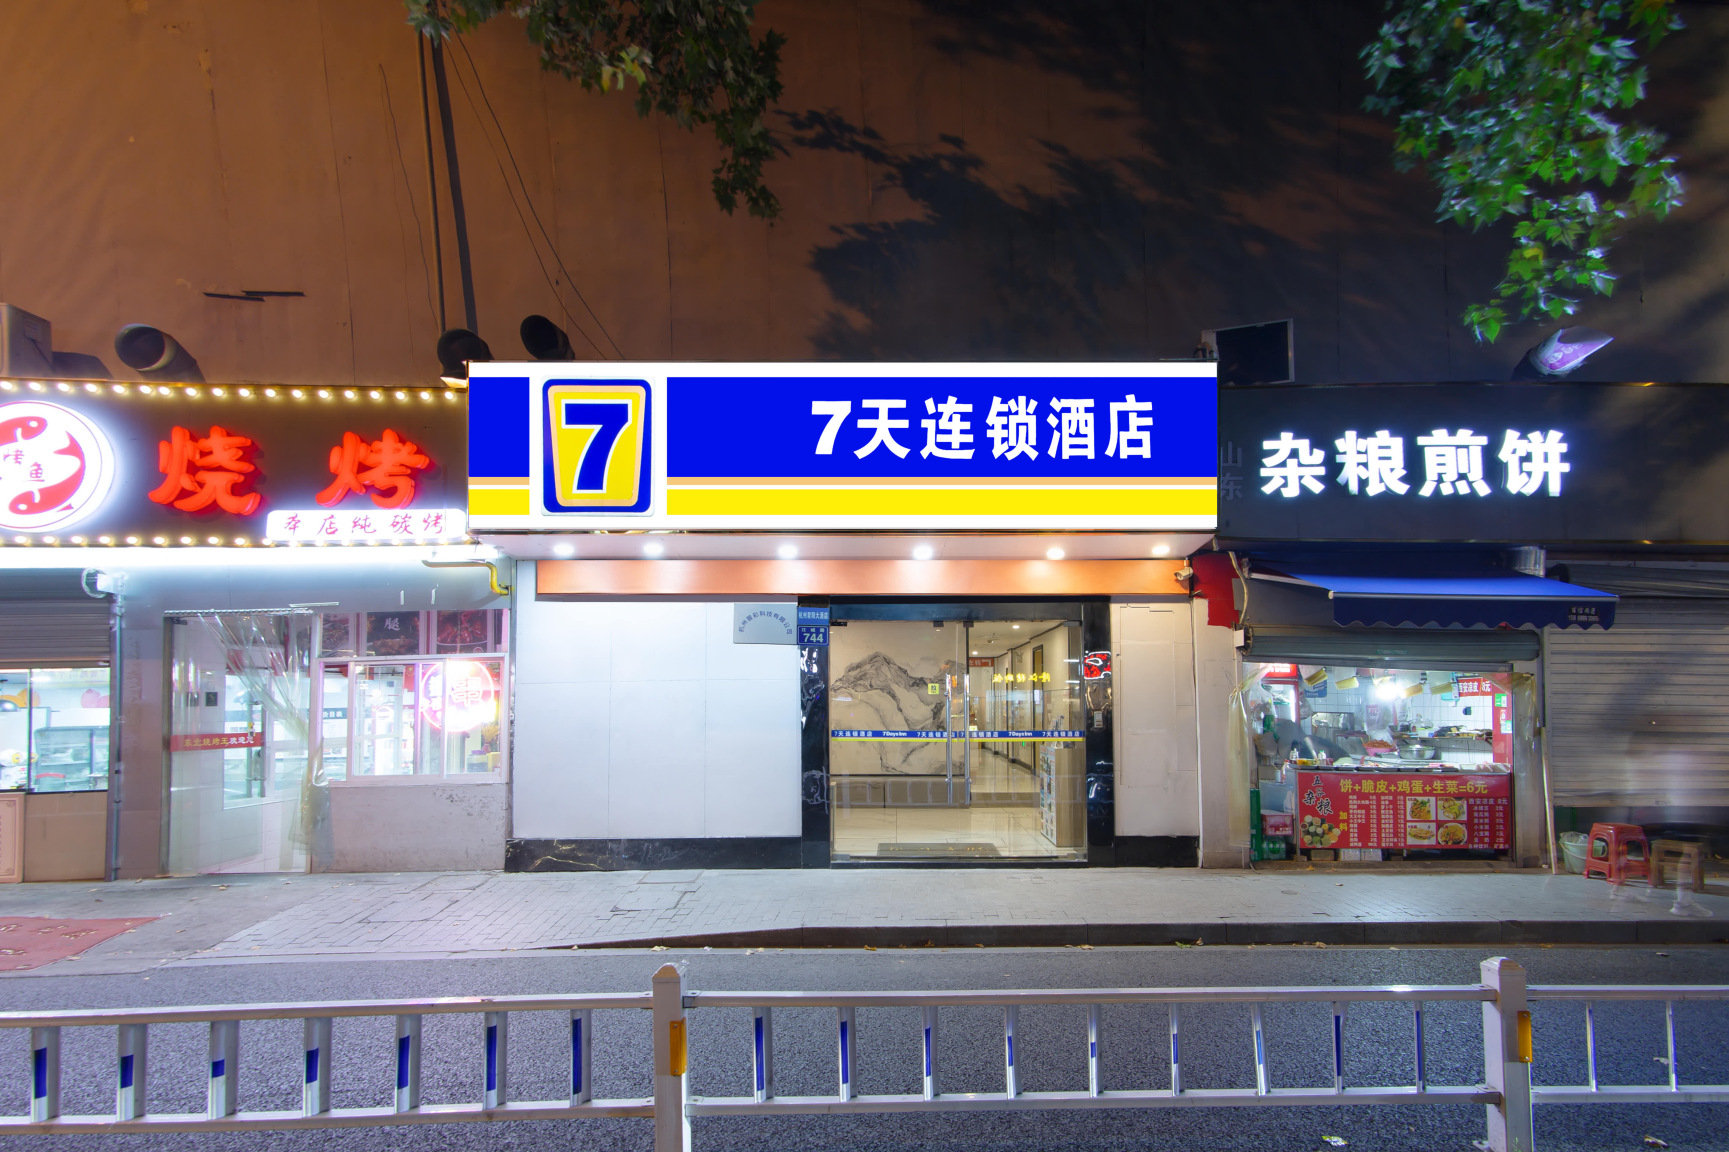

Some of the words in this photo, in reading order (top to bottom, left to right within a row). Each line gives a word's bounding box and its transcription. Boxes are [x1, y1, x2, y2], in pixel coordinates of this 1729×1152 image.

[561, 400, 630, 493] 7
[811, 394, 1154, 461] 7天连锁酒店
[148, 425, 430, 516] 烧烤
[1220, 440, 1243, 501] 山东
[1259, 427, 1571, 499] 杂粮煎饼
[384, 617, 401, 631] 腿
[803, 633, 823, 642] 744
[1340, 779, 1488, 795] 饼+脆皮+鸡蛋+生菜=6元
[1339, 810, 1348, 832] 加料
